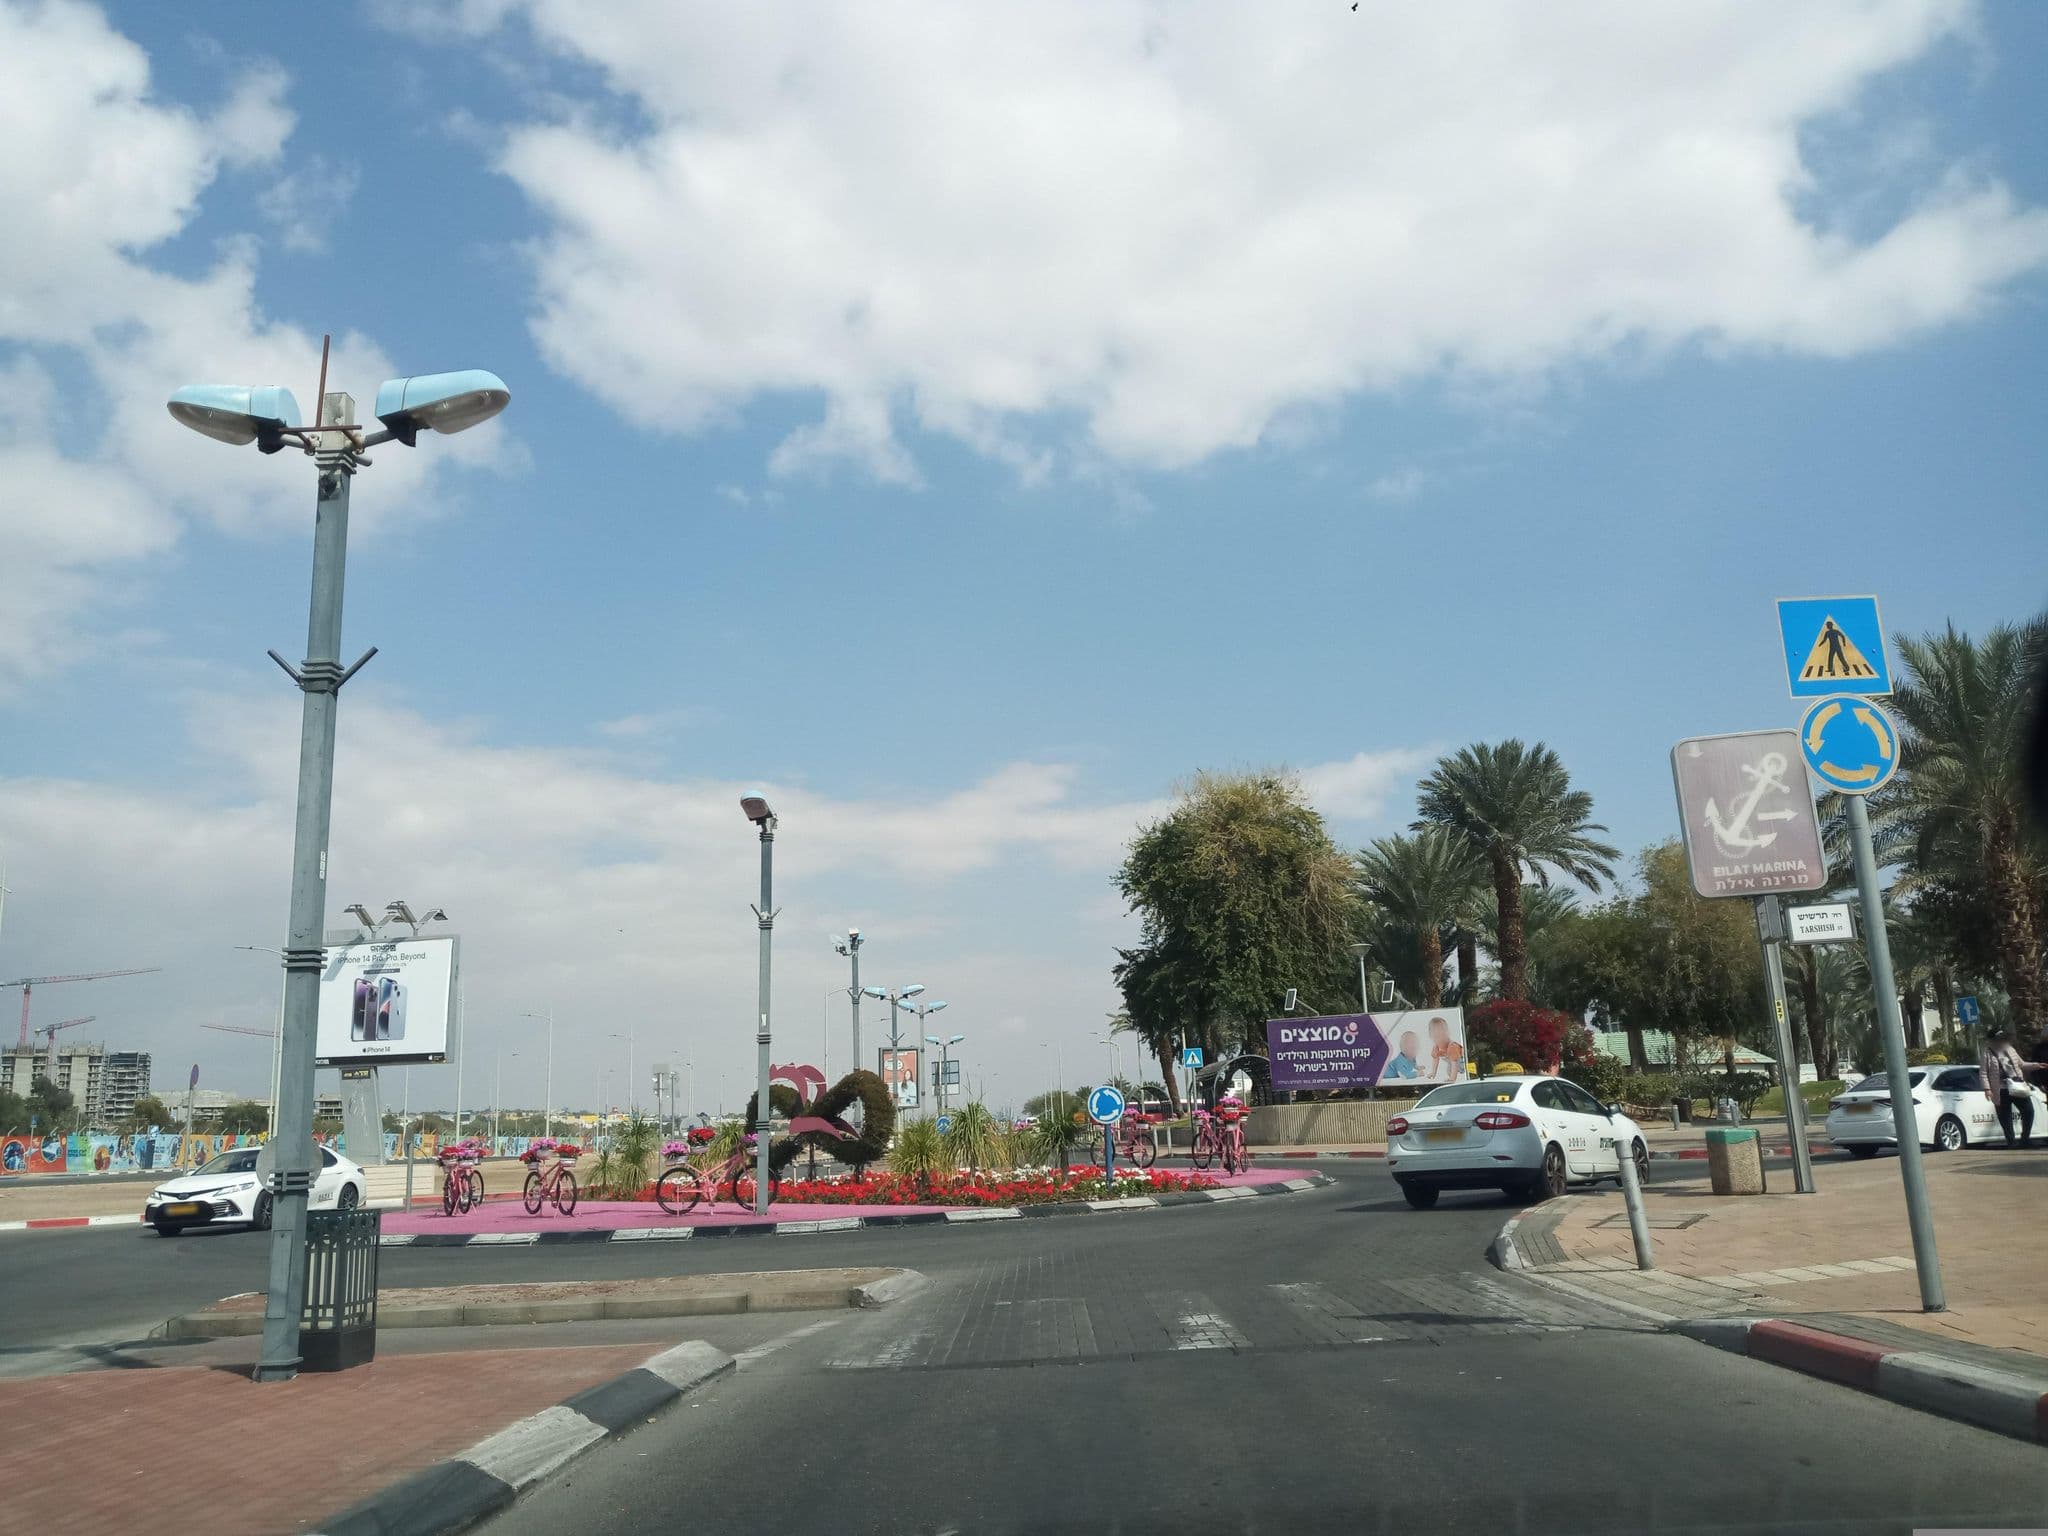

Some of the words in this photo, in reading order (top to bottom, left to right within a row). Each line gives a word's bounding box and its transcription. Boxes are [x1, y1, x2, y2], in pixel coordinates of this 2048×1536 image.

[1713, 864, 1750, 876] EILAT
[1753, 859, 1807, 873] MARINA
[1715, 878, 1755, 891] אילת
[1761, 874, 1808, 887] מרינה
[1797, 912, 1828, 920] תרשיש
[1800, 924, 1835, 933] TARSHISH
[337, 956, 361, 964] iPhone
[1280, 1026, 1342, 1043] מוצצים
[1277, 1050, 1309, 1061] והילדים
[1310, 1049, 1350, 1060] התינוקות
[1352, 1048, 1371, 1059] קניון
[1293, 1063, 1328, 1073] בישראל
[1329, 1061, 1355, 1071] הגדול
